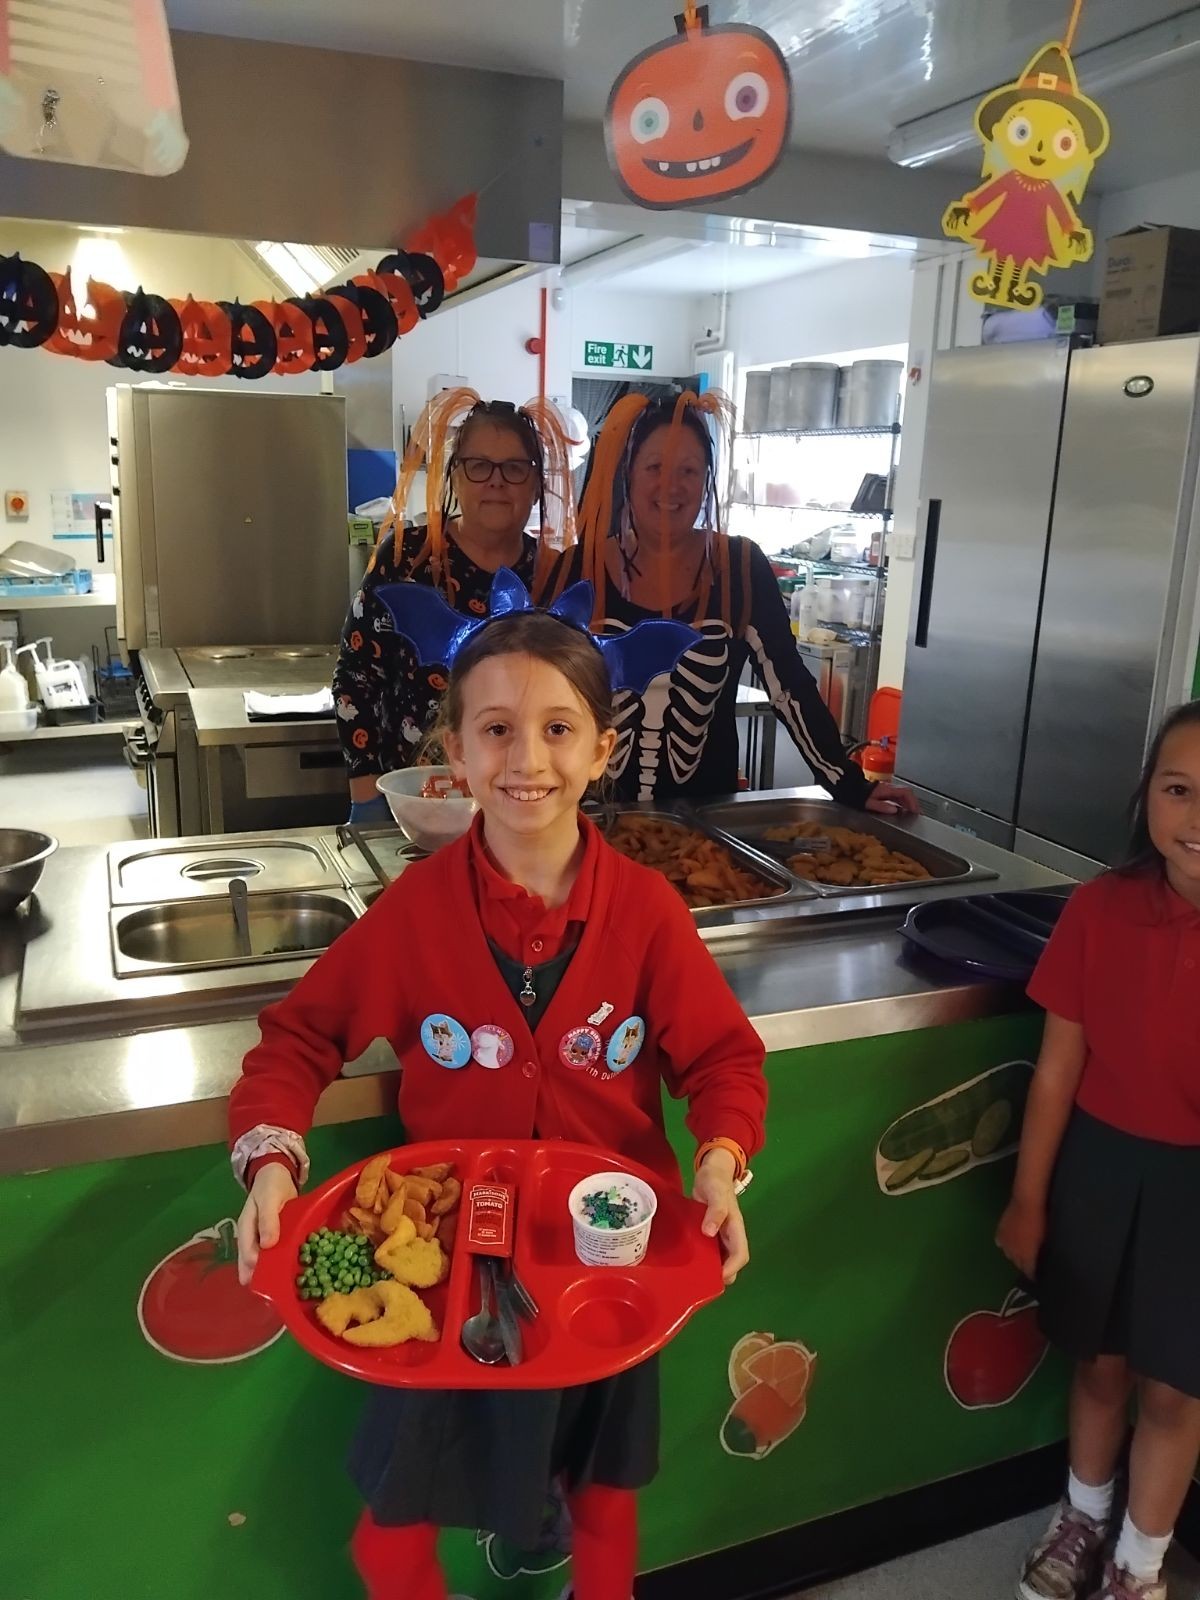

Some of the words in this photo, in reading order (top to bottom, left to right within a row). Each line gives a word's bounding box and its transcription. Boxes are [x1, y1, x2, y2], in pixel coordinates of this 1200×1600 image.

[587, 343, 607, 354] Fire
[588, 354, 607, 364] exit
[567, 1028, 590, 1039] HAPPY
[590, 1030, 602, 1061] BIRTHDAY
